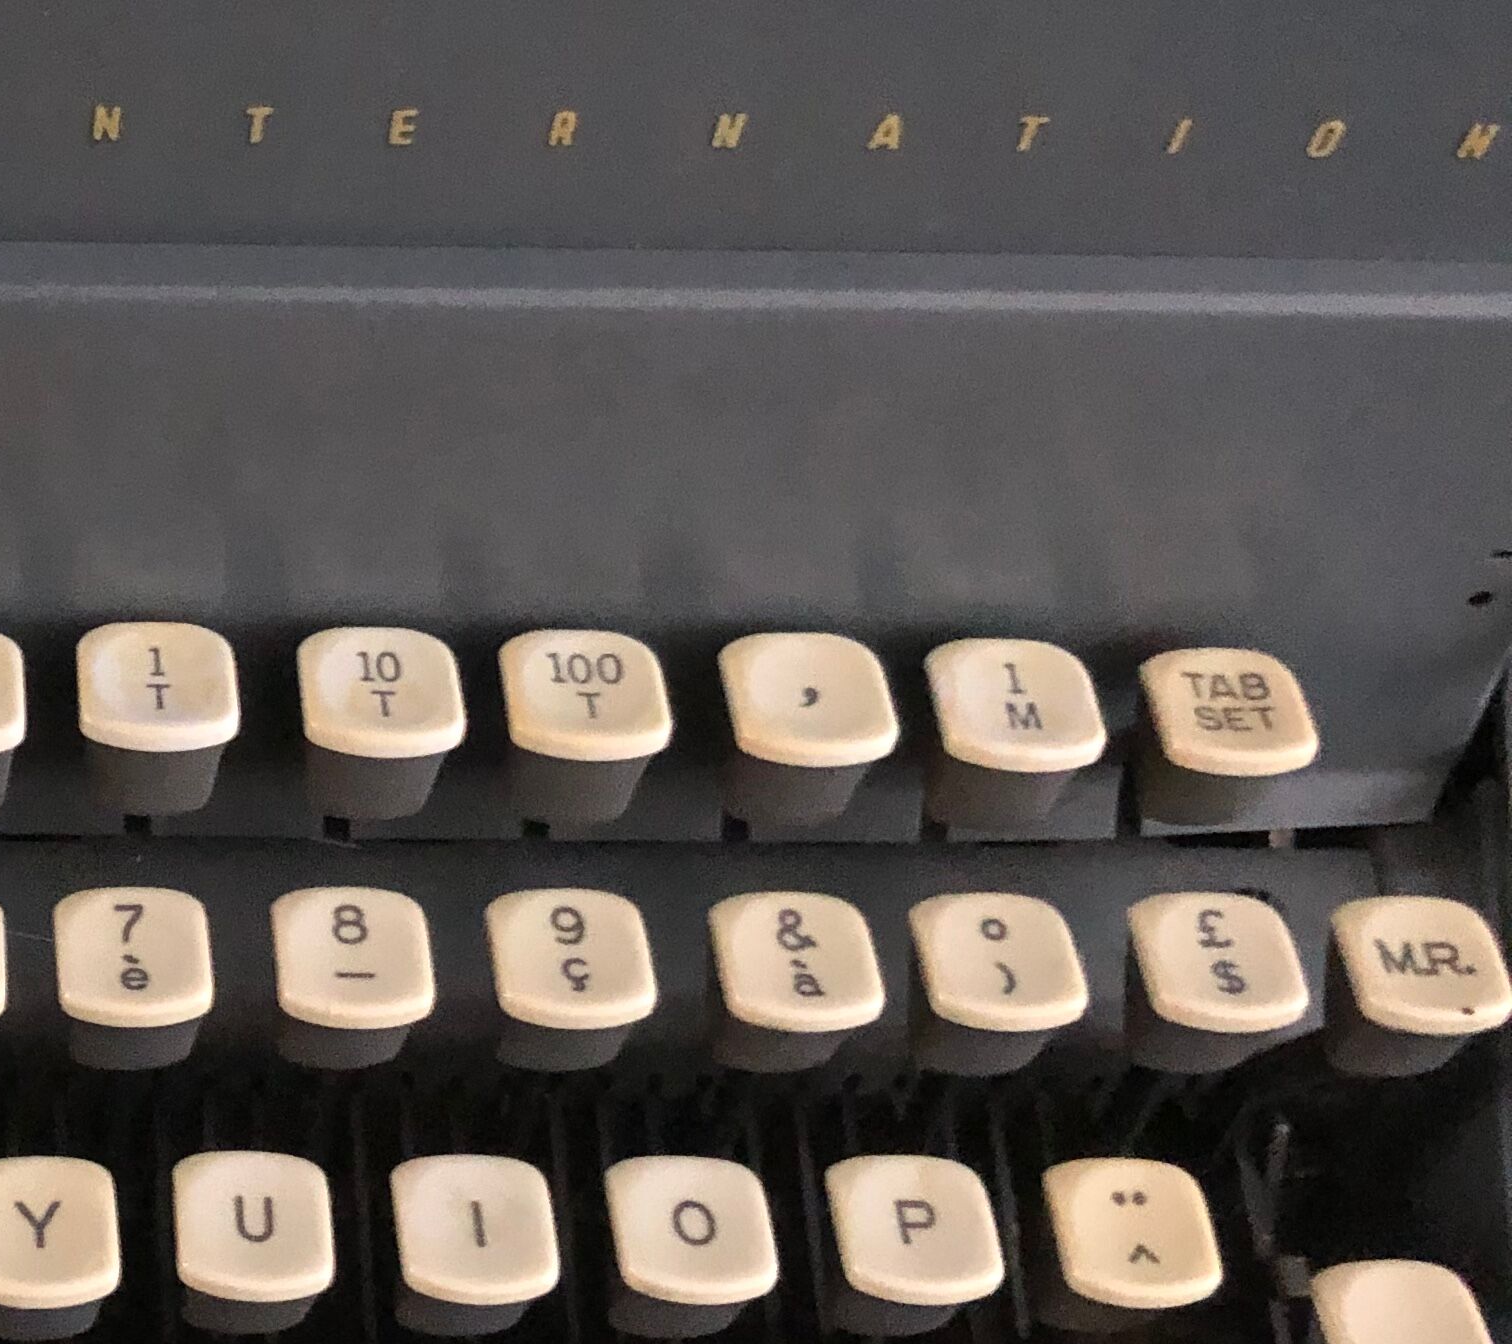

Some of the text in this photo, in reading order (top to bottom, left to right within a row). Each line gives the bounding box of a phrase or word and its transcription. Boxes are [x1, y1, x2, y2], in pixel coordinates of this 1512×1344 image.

[148, 646, 166, 677] 1
[357, 651, 402, 683] 10
[547, 652, 625, 686] 100
[1003, 662, 1027, 696] 1
[146, 683, 171, 711] T
[370, 689, 397, 718] T
[576, 691, 602, 720] T
[1182, 671, 1272, 703] TAB
[1005, 702, 1043, 731] M
[1194, 705, 1275, 733] SET
[113, 903, 144, 944] 7
[332, 904, 369, 946] 8
[550, 905, 586, 946] 9
[776, 908, 818, 953] &
[1198, 909, 1234, 949] £
[119, 954, 150, 992] è
[561, 957, 591, 993] ç
[1211, 959, 1247, 996] $
[14, 1200, 61, 1249] Y
[234, 1195, 275, 1244] U
[470, 1200, 487, 1248] I
[672, 1199, 717, 1247] O
[894, 1199, 937, 1245] P
